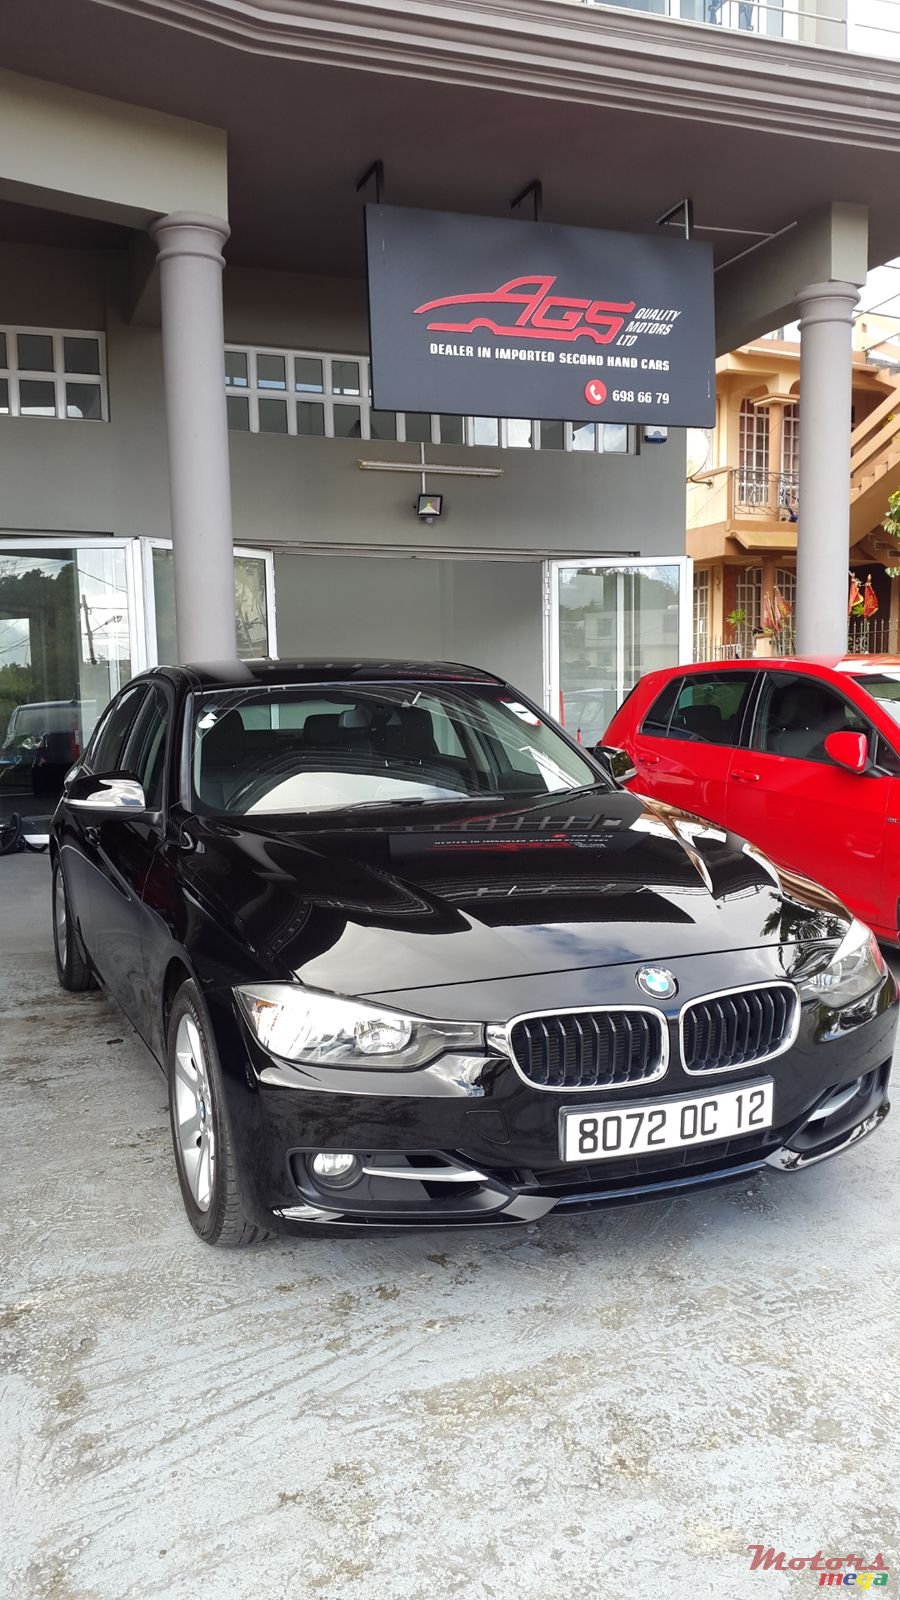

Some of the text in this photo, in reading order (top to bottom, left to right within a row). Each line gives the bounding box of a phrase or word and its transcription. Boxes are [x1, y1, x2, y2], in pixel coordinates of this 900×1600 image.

[413, 275, 636, 344] AGS
[634, 307, 682, 322] QUALITY
[624, 320, 674, 336] MOTORS
[615, 334, 639, 347] LTD
[429, 343, 670, 372] DEALER IN IMPORTED SECOND HAND CARS
[612, 389, 670, 405] 698 66 79
[578, 1110, 667, 1155] 8072
[735, 1090, 766, 1127] 12
